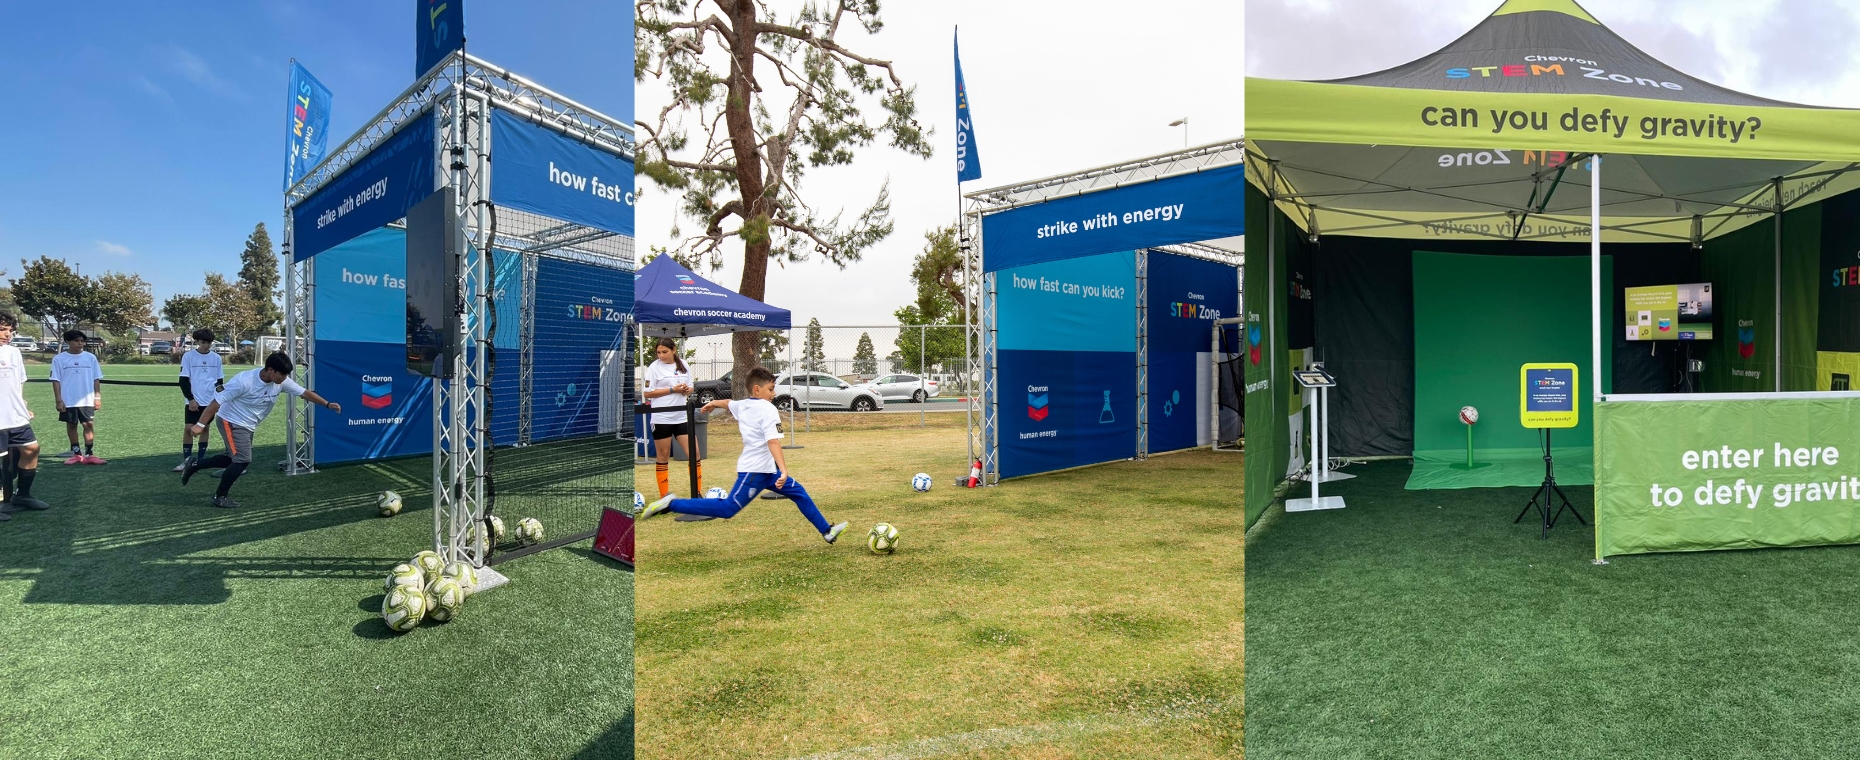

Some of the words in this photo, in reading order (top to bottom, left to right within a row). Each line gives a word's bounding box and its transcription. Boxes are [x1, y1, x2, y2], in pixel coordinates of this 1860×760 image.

[431, 0, 448, 49] ST
[1524, 55, 1598, 67] Chevron
[1445, 64, 1565, 79] STEM
[1580, 66, 1684, 91] Zone
[293, 80, 312, 138] STEM
[1420, 105, 1478, 129] can
[1491, 109, 1548, 133] you
[1559, 107, 1629, 138] defy
[1640, 113, 1762, 142] gravity?
[302, 126, 314, 159] Chevron
[957, 117, 970, 172] Zone
[288, 140, 300, 187] Zon
[549, 162, 586, 191] how
[592, 176, 620, 203] fast
[624, 191, 634, 206] c
[317, 209, 337, 229] strike
[338, 195, 354, 218] with
[355, 176, 388, 207] energy
[1037, 220, 1078, 239] strike
[1083, 212, 1118, 231] with
[1122, 203, 1184, 225] energy
[342, 268, 377, 286] how
[383, 274, 405, 289] fas
[1013, 273, 1037, 290] how
[1040, 276, 1060, 293] fast
[1062, 283, 1080, 295] can
[1082, 285, 1100, 298] you
[1102, 284, 1125, 300] kick?
[1188, 291, 1205, 300] Chevron
[567, 304, 602, 320] STEM
[673, 307, 706, 317] chevron
[707, 310, 732, 318] soccer
[733, 311, 766, 321] academy
[1170, 301, 1197, 318] STEM
[1199, 304, 1221, 320] Zone
[362, 374, 393, 382] Chevron
[348, 418, 376, 426] human
[1019, 431, 1038, 439] human
[1682, 445, 1764, 469] enter
[1774, 442, 1839, 467] here
[1650, 483, 1683, 507] to
[1694, 478, 1763, 509] defy
